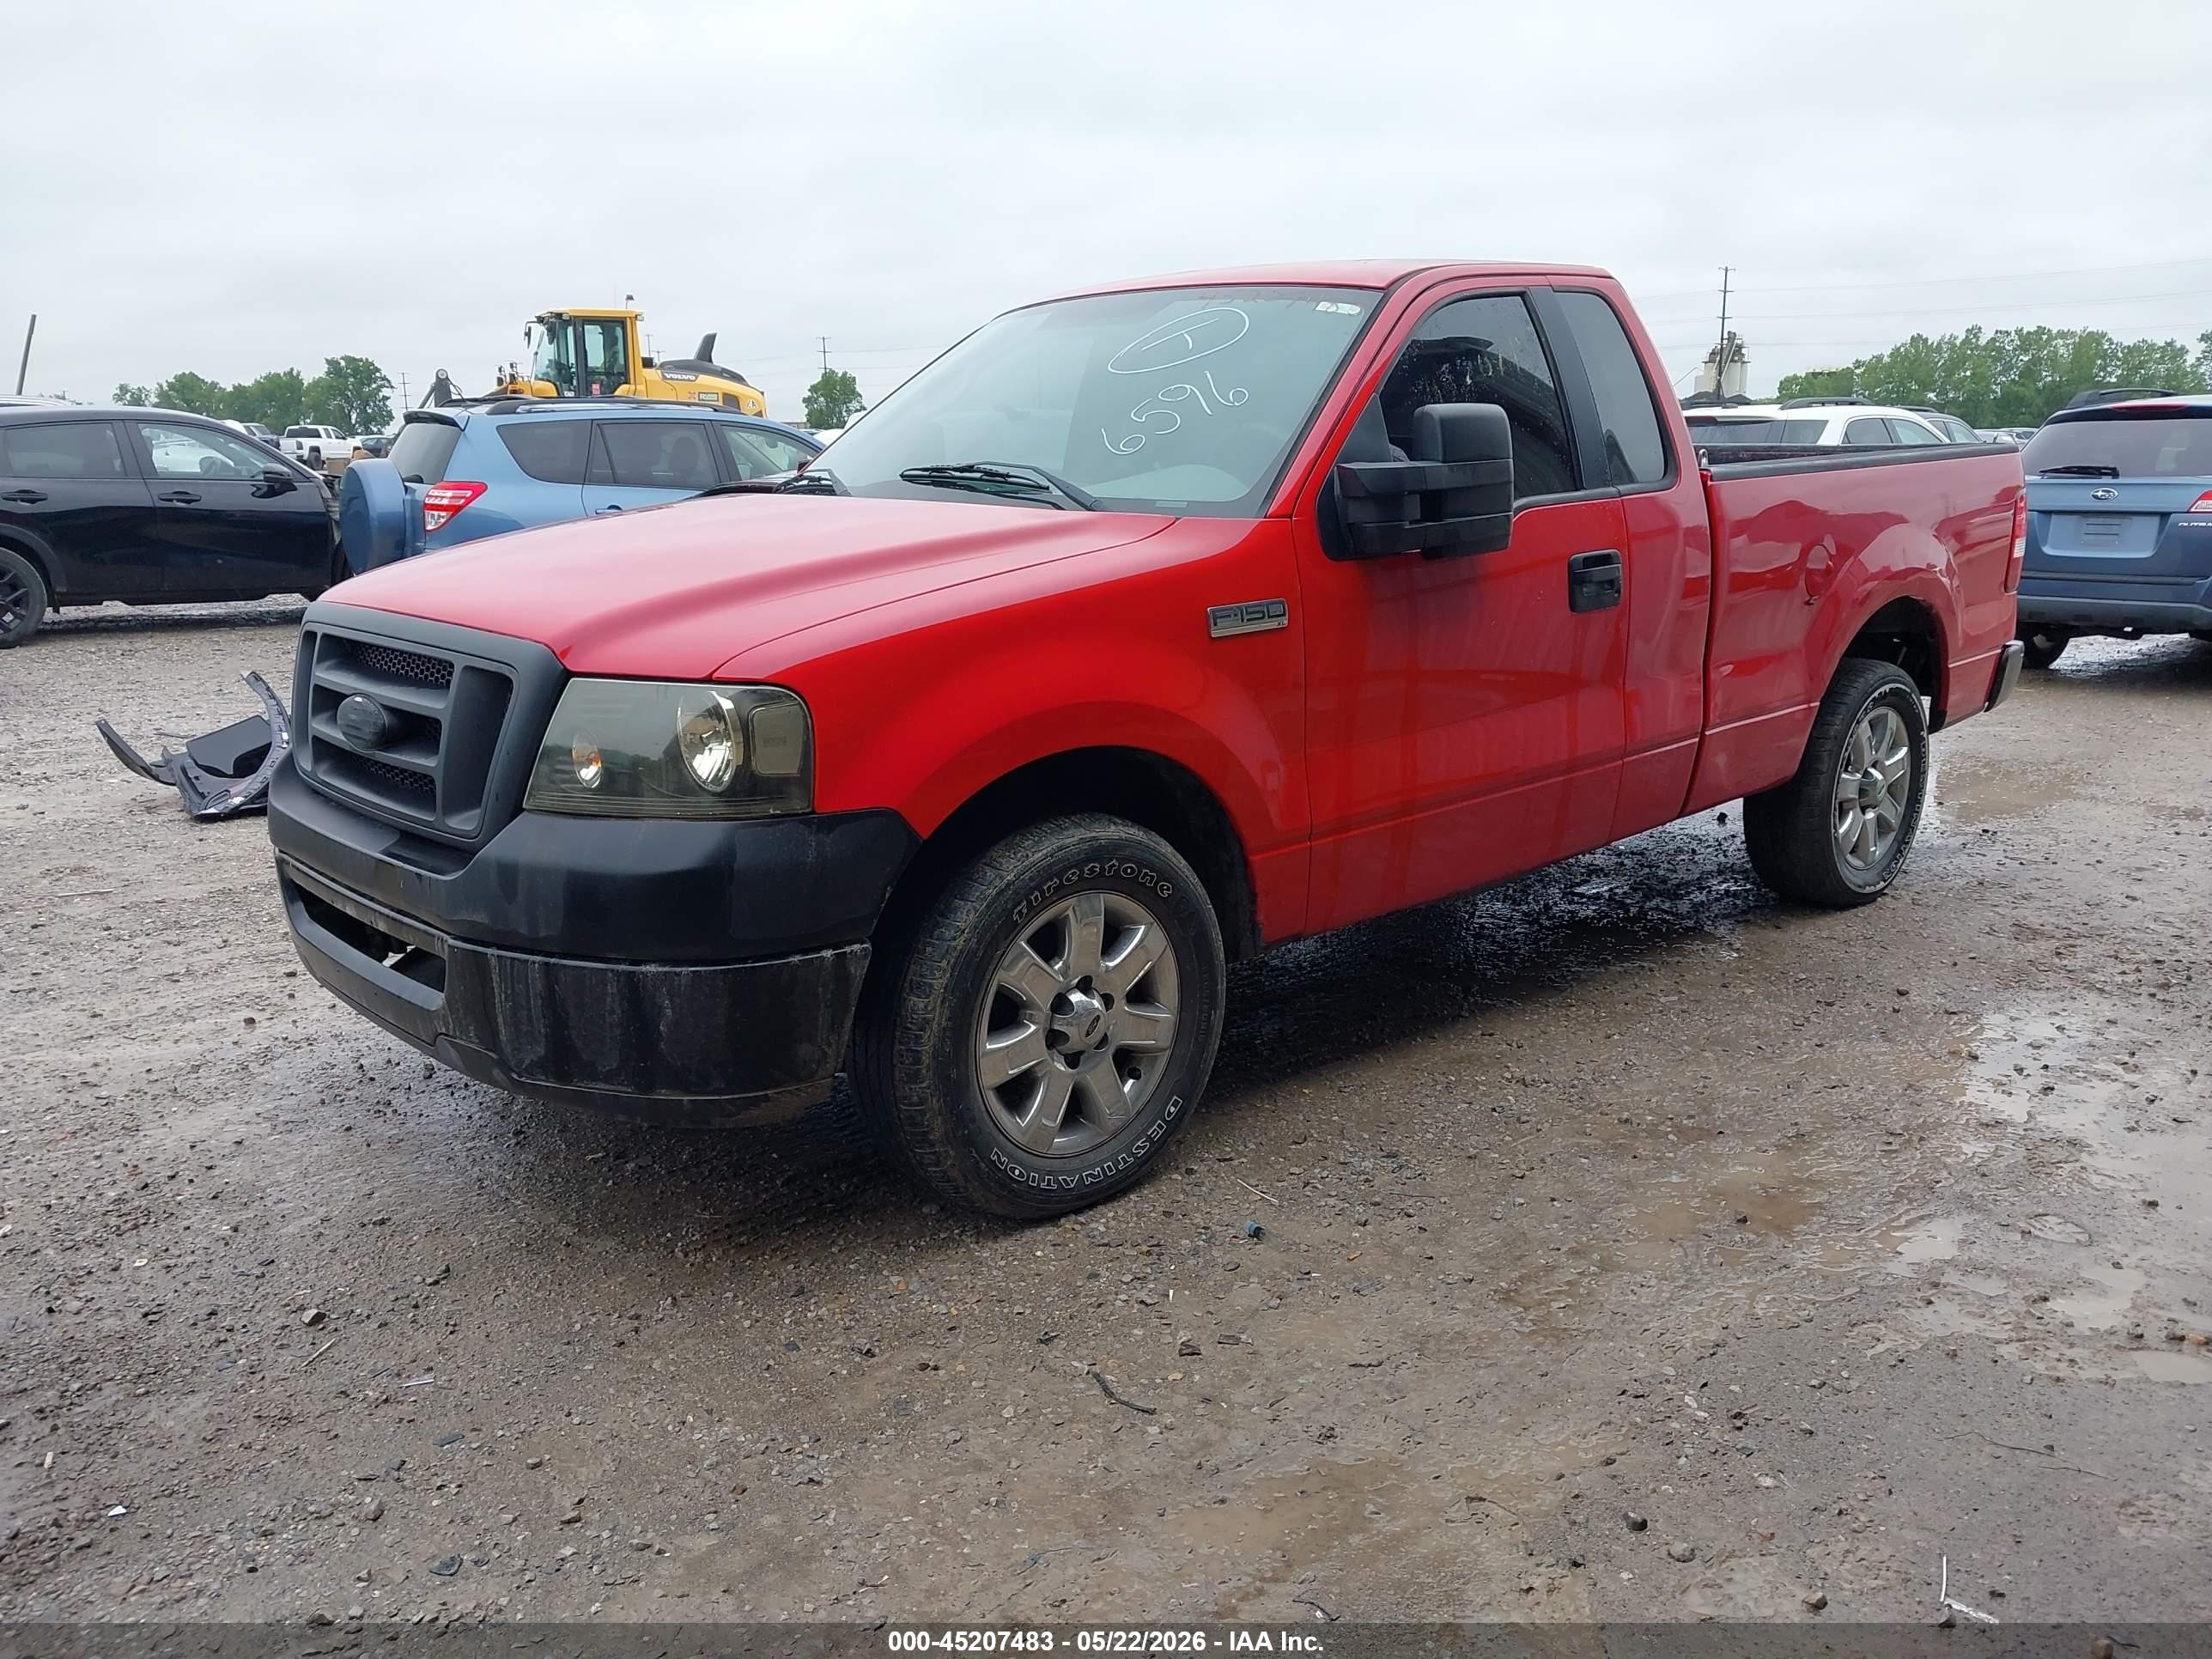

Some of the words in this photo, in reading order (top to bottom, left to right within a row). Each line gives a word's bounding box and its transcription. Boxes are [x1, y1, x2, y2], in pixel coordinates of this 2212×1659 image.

[1101, 370, 1249, 455] 6596
[1211, 603, 1286, 626] F-150
[1012, 860, 1173, 923] Firestone
[989, 1096, 1184, 1190] DESTINATION
